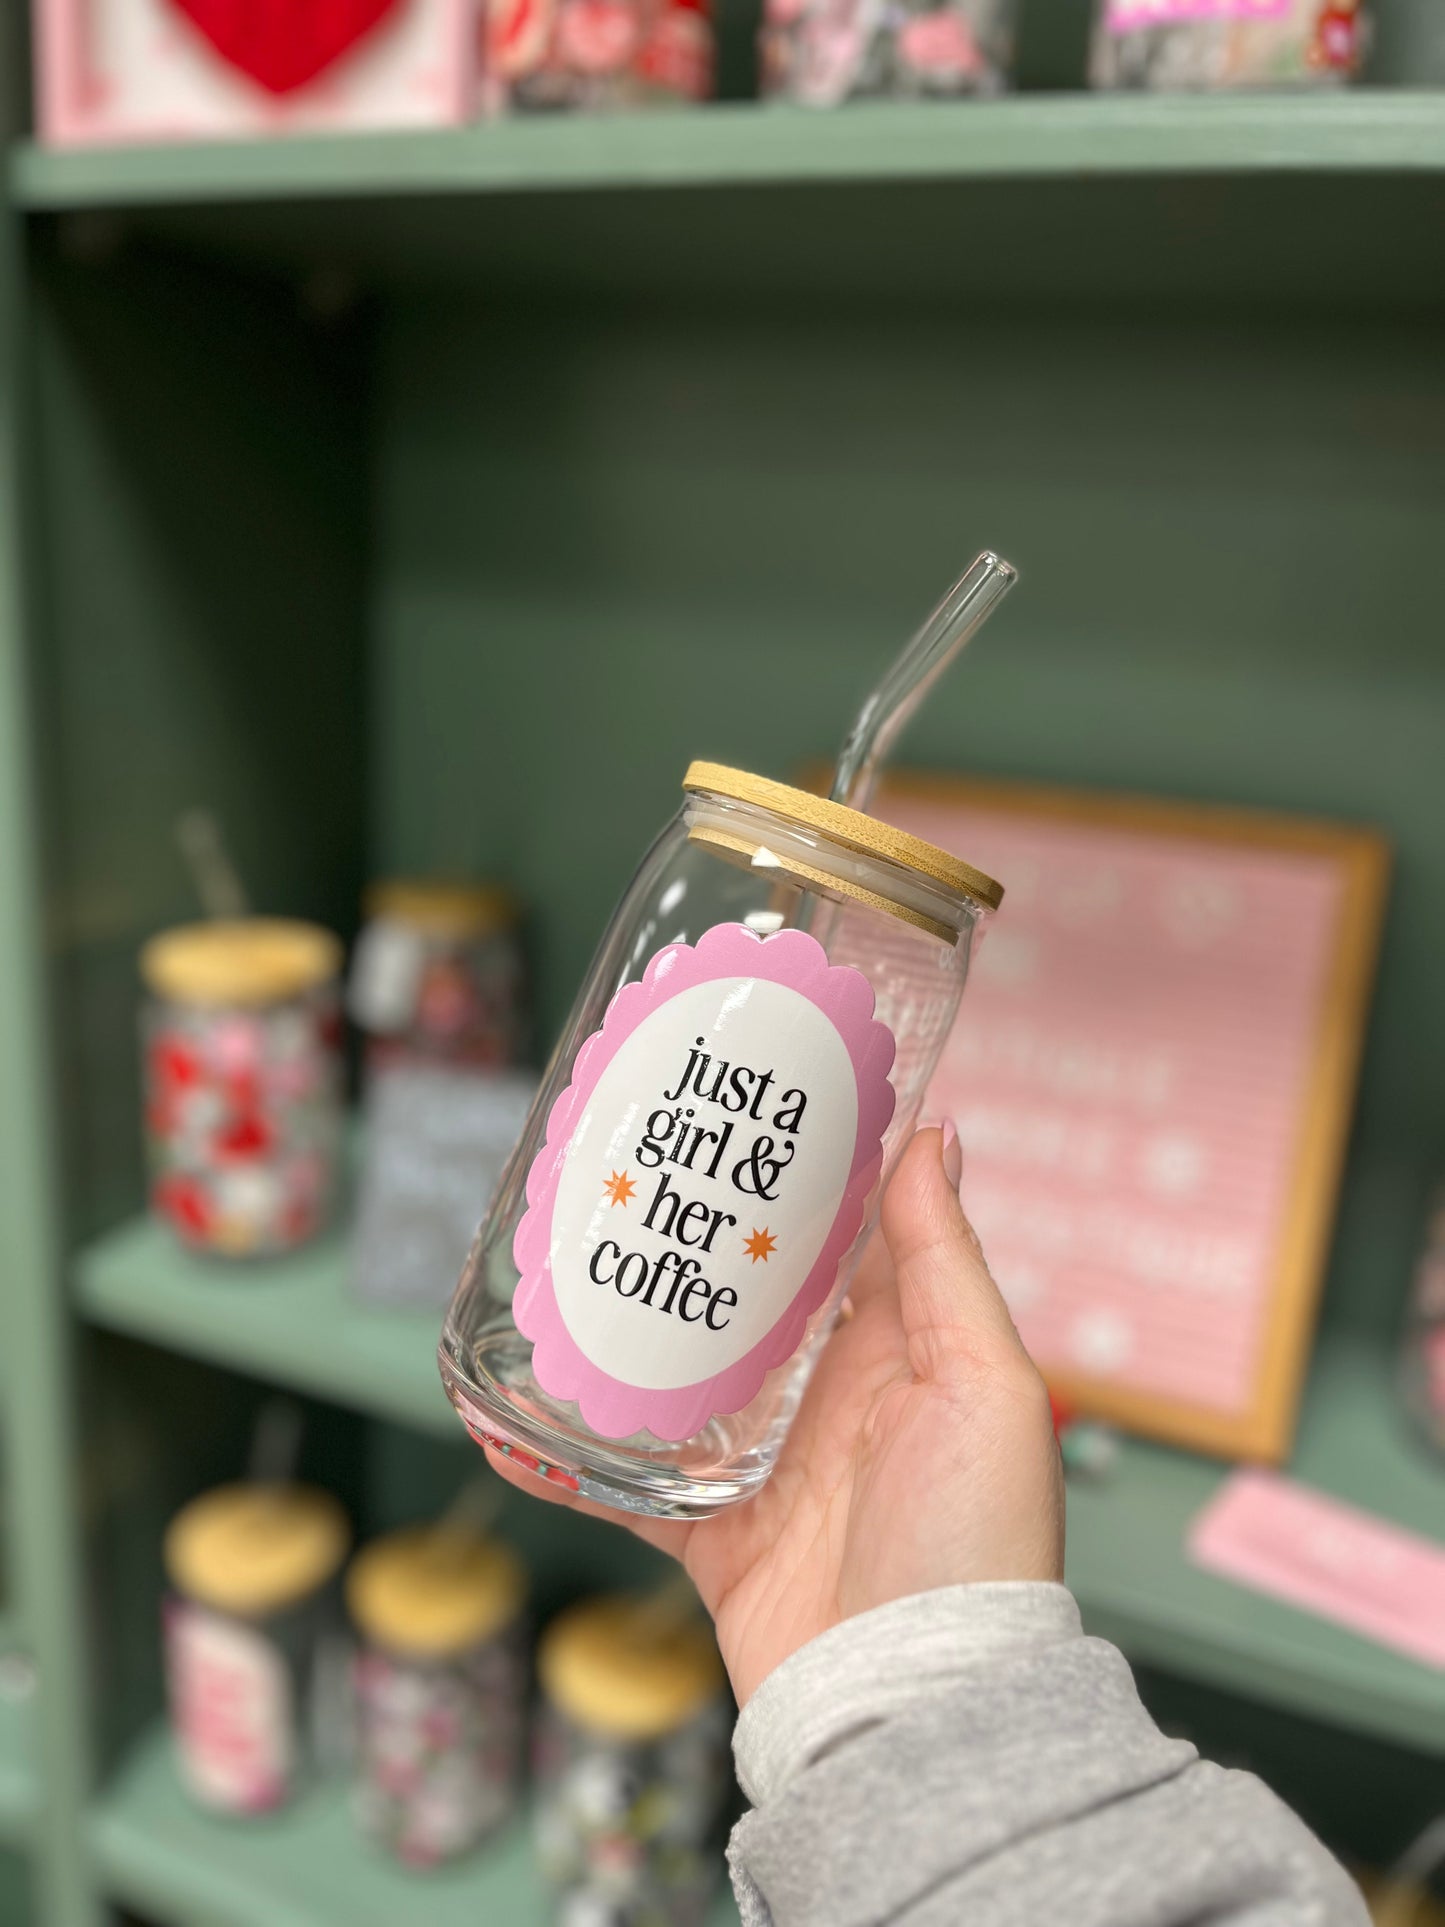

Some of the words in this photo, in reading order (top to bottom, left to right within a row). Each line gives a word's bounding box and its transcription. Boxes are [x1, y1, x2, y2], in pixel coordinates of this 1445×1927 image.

[664, 1036, 776, 1120] just
[773, 1088, 807, 1134] a
[636, 1107, 734, 1179] girl
[732, 1135, 795, 1200] &
[641, 1172, 736, 1253] her
[589, 1240, 738, 1331] coffee
